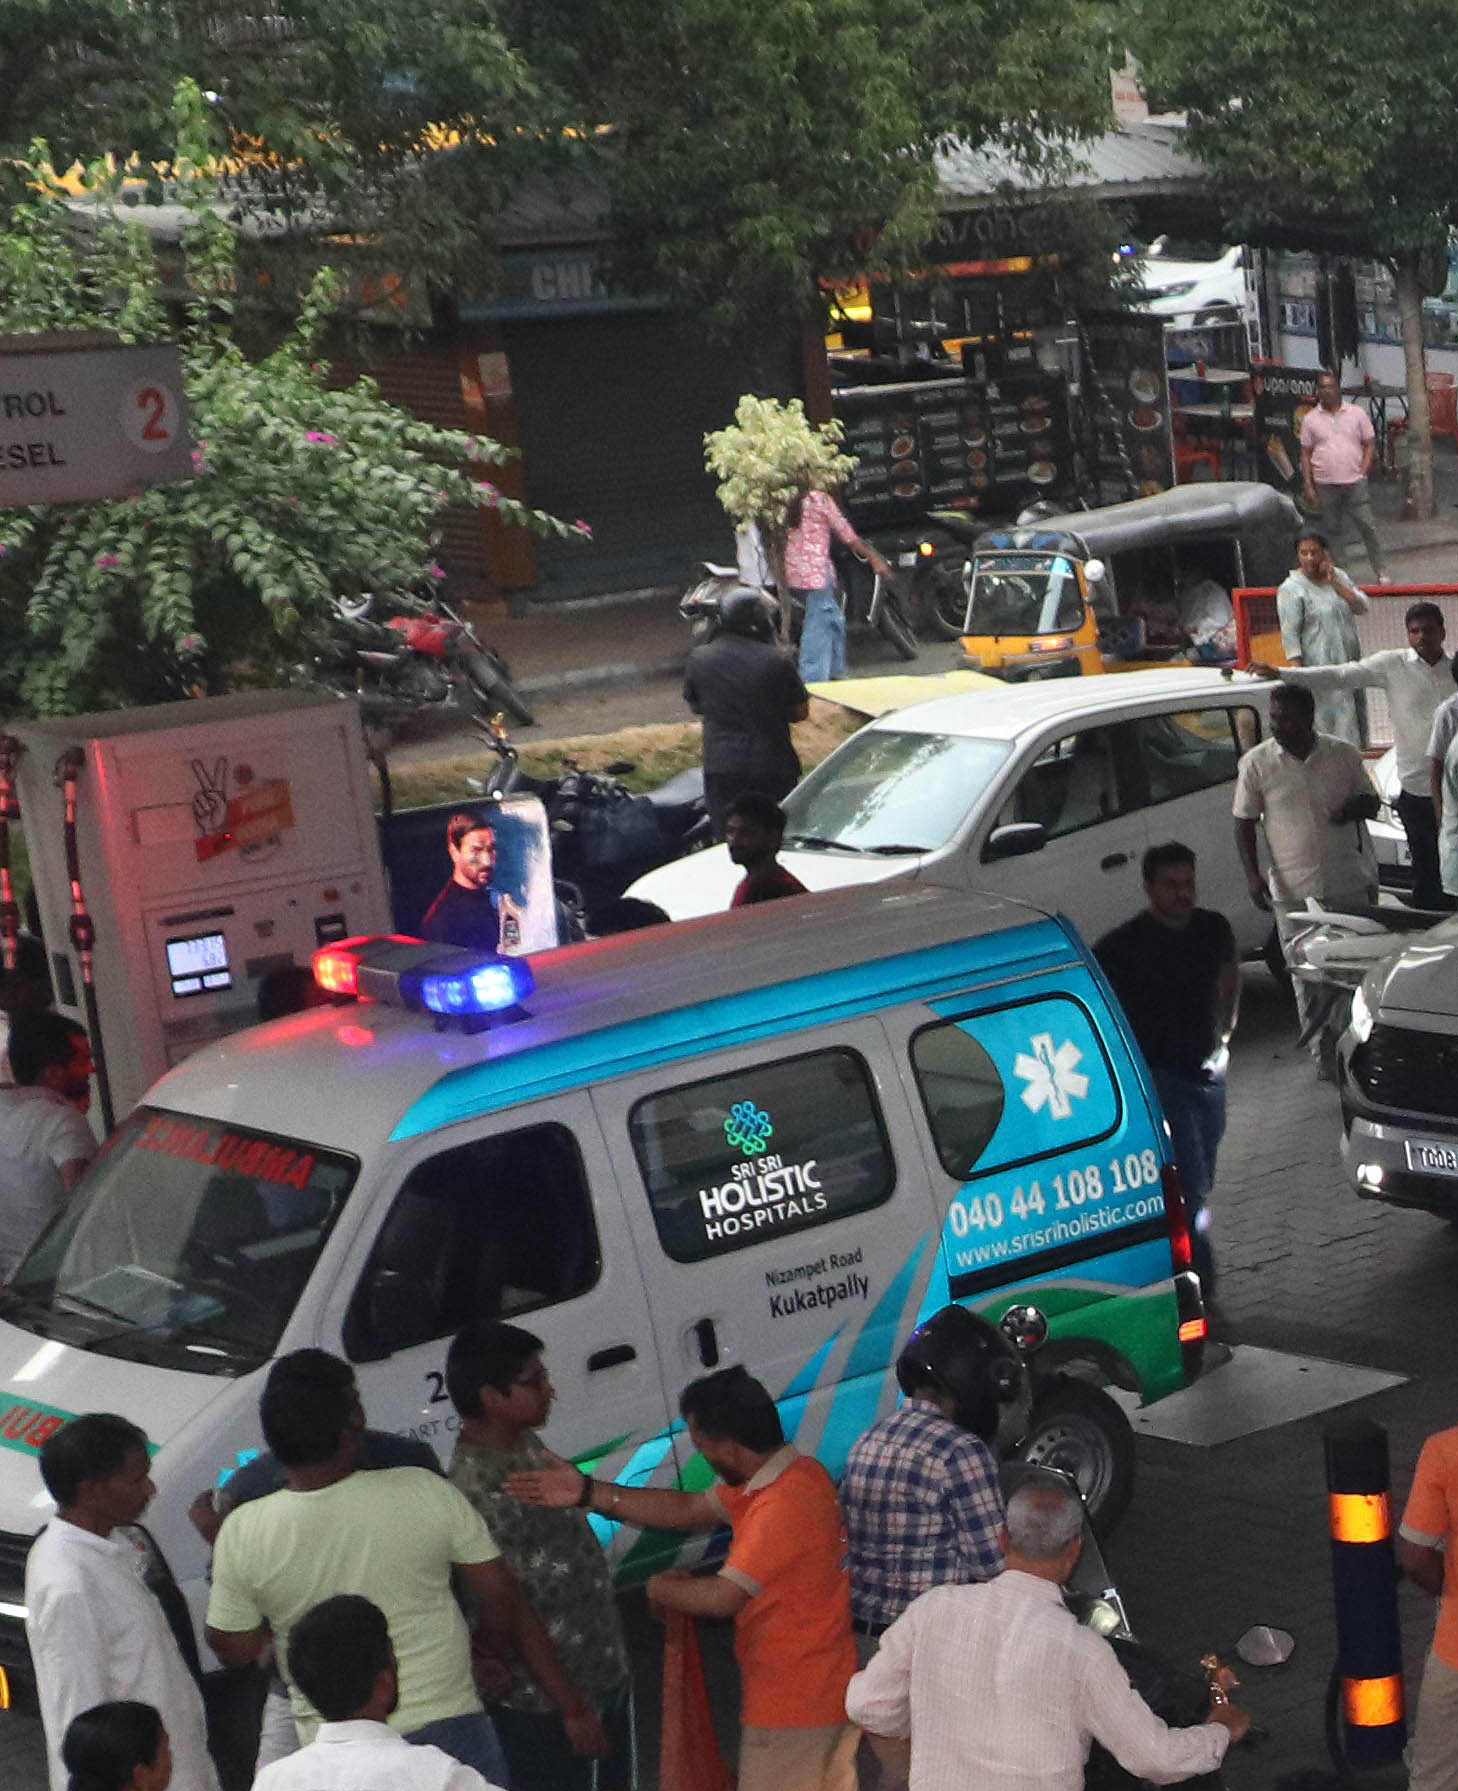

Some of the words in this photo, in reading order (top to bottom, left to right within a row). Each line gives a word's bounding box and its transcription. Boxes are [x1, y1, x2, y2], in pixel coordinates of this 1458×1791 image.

[137, 386, 170, 441] 2
[699, 1160, 822, 1219] HOLISTIC
[731, 1161, 756, 1181] SRI
[757, 1154, 783, 1174] SRI
[950, 1192, 1004, 1237] 040
[1010, 1181, 1046, 1220] 44
[1053, 1164, 1105, 1211] 108
[1108, 1149, 1160, 1194] 108
[705, 1192, 829, 1241] HOSPITALS
[956, 1195, 1166, 1267] www.srisriholistic.com
[765, 1259, 829, 1288] Nizampet
[829, 1247, 864, 1271] Road
[769, 1272, 870, 1319] Kukatpally
